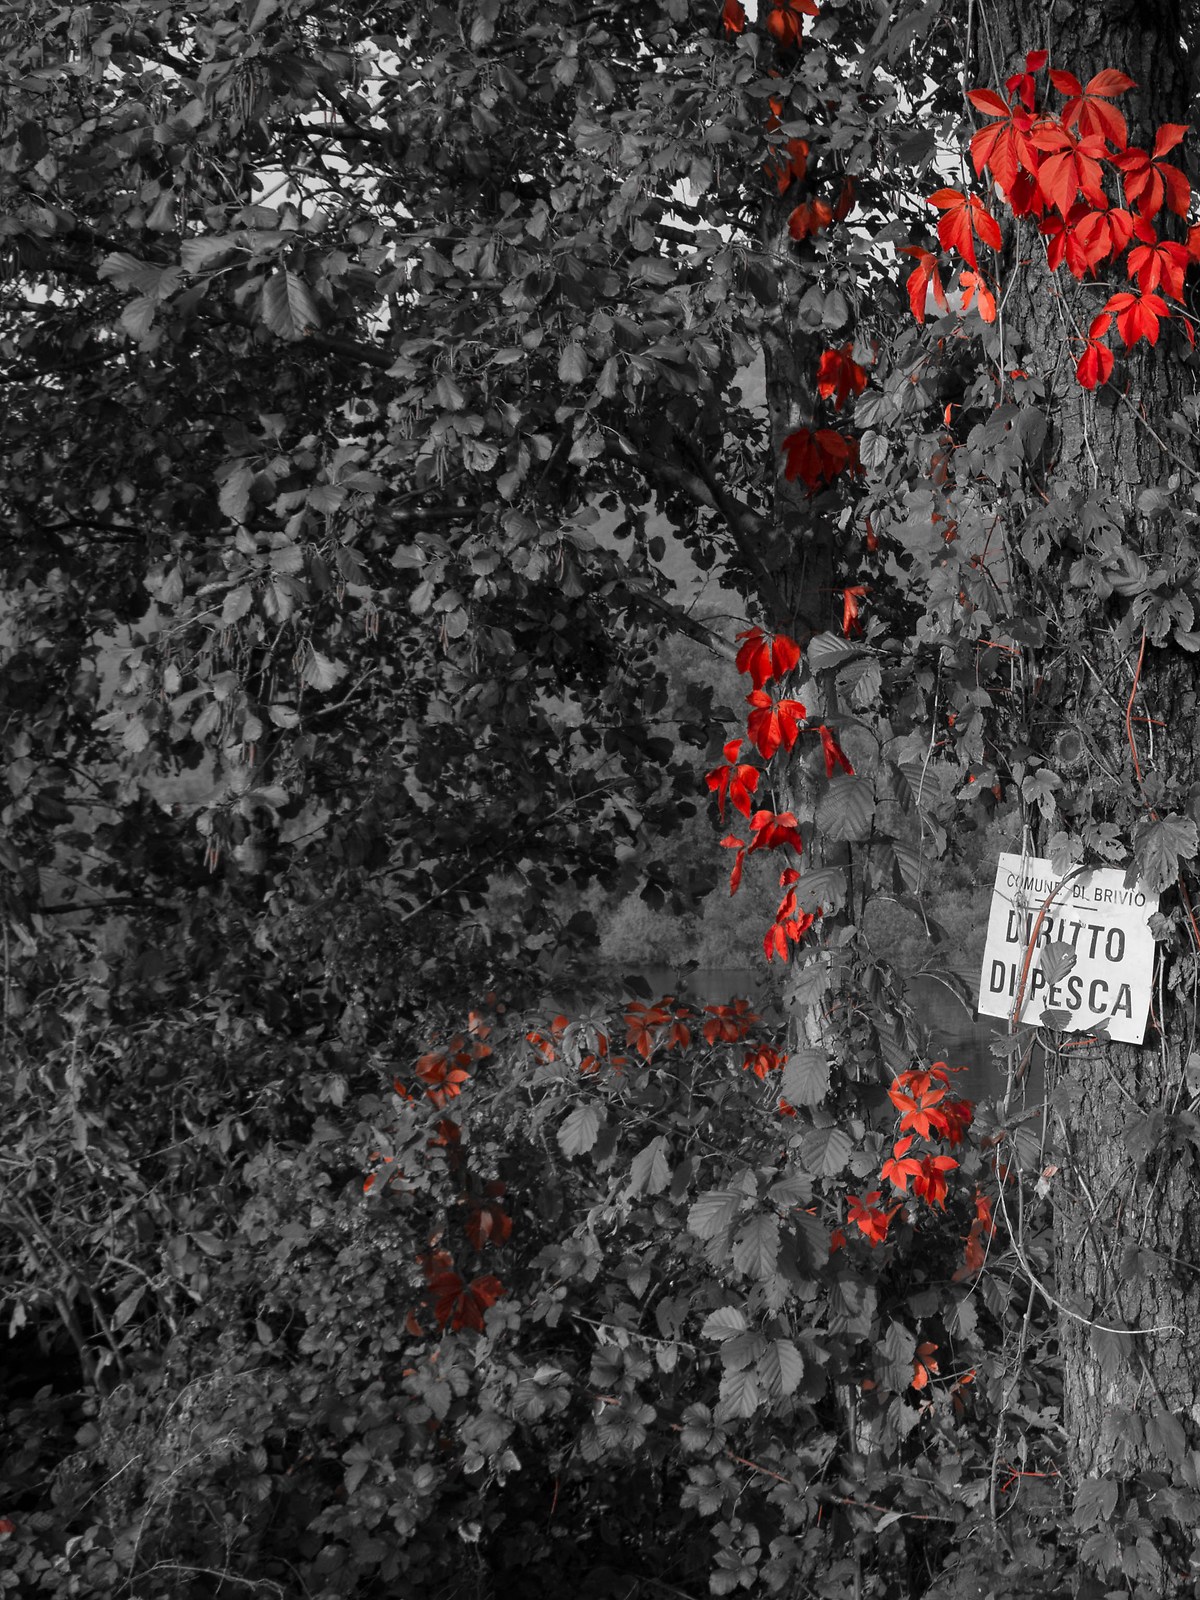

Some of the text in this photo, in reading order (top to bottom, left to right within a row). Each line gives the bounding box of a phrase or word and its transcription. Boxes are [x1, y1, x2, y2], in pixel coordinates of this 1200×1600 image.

[1072, 884, 1085, 900] DI
[1094, 887, 1146, 907] BRIVIO
[1005, 909, 1126, 963] DIRITTO
[989, 959, 1133, 1019] DI PESCA
